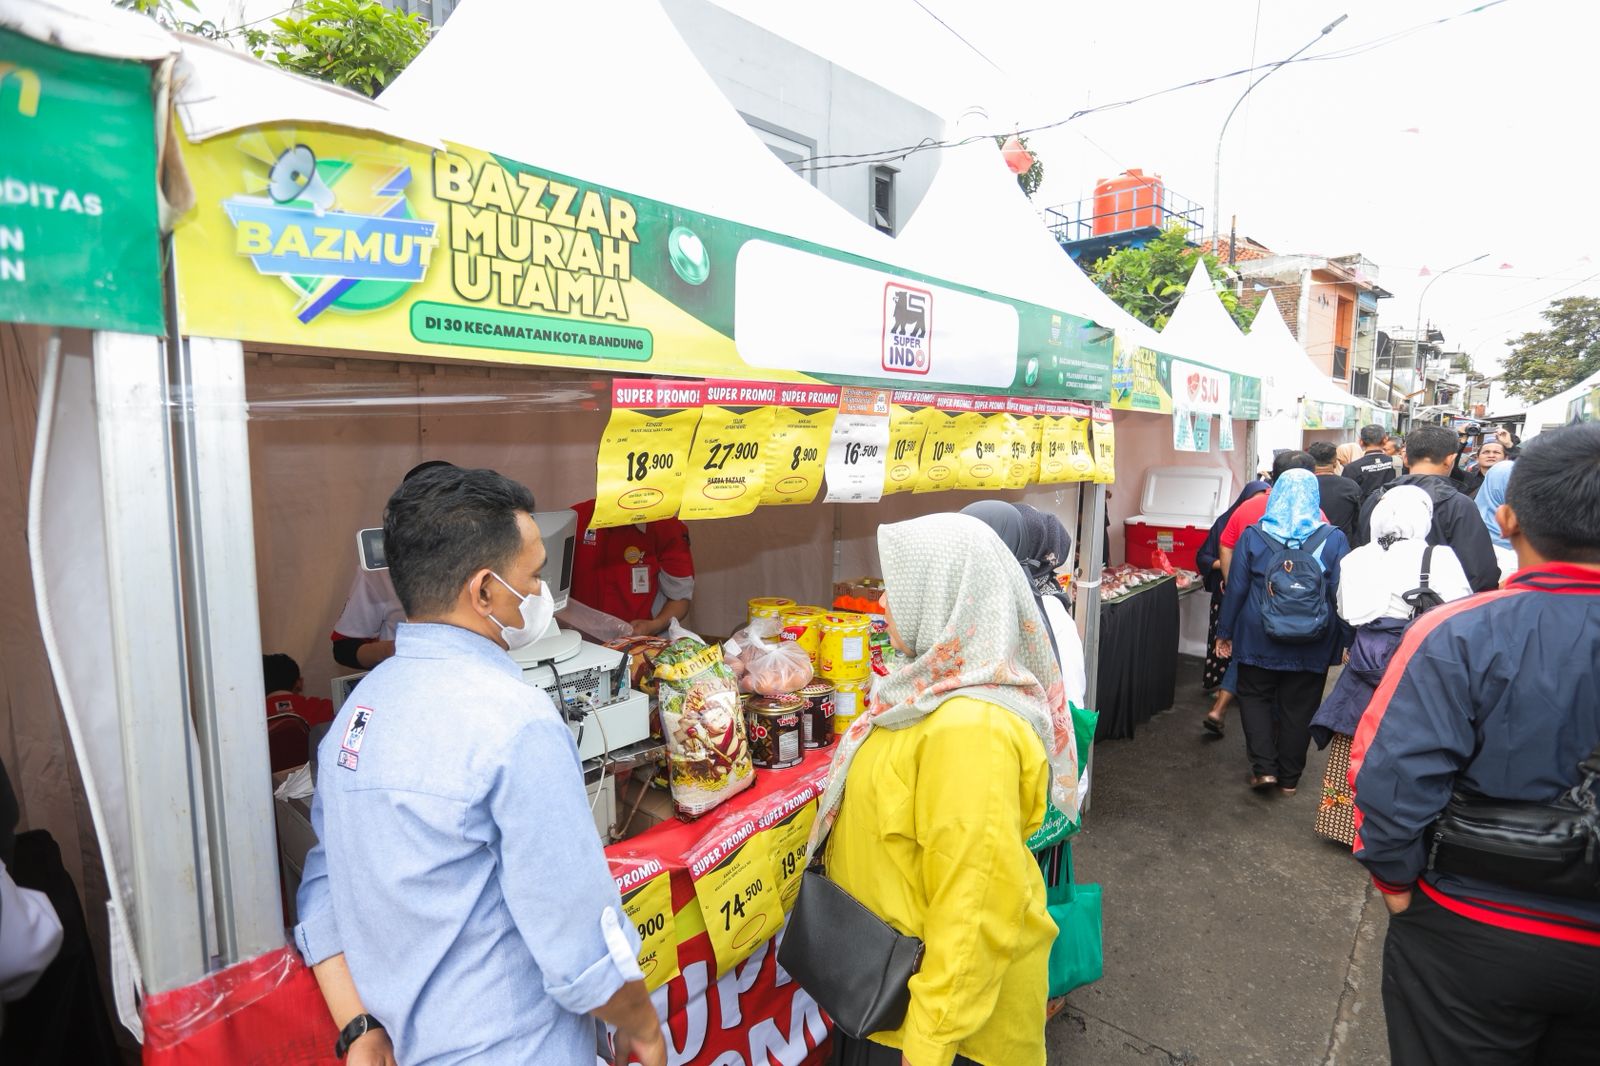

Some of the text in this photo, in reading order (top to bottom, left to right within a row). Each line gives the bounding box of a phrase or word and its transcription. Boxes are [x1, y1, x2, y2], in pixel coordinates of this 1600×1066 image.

[433, 148, 640, 243] BAZZAR
[237, 220, 440, 268] BAZMUT
[450, 203, 632, 281] MURAH
[452, 250, 630, 321] UTAMA
[425, 316, 441, 330] DI
[444, 318, 463, 332] 30
[589, 335, 644, 350] BANDUNG
[893, 336, 921, 349] SUPER
[889, 346, 925, 368] INDO
[616, 388, 700, 404] SUPER PROMO!
[707, 387, 776, 402] SUPER PROMO!
[781, 390, 806, 404] SUPER
[808, 391, 838, 405] PROMO!
[894, 390, 912, 401] SUPER
[627, 451, 673, 482] 18.900
[703, 442, 759, 470] 27.900
[791, 446, 818, 470] 8.900
[844, 442, 878, 465] 16.500
[758, 788, 814, 829] SUPER PROMO!
[691, 847, 722, 877] SUPER
[720, 820, 755, 854] PROMO!
[615, 859, 663, 891] PROMO!
[720, 878, 763, 931] 74.500
[637, 913, 665, 942] 900
